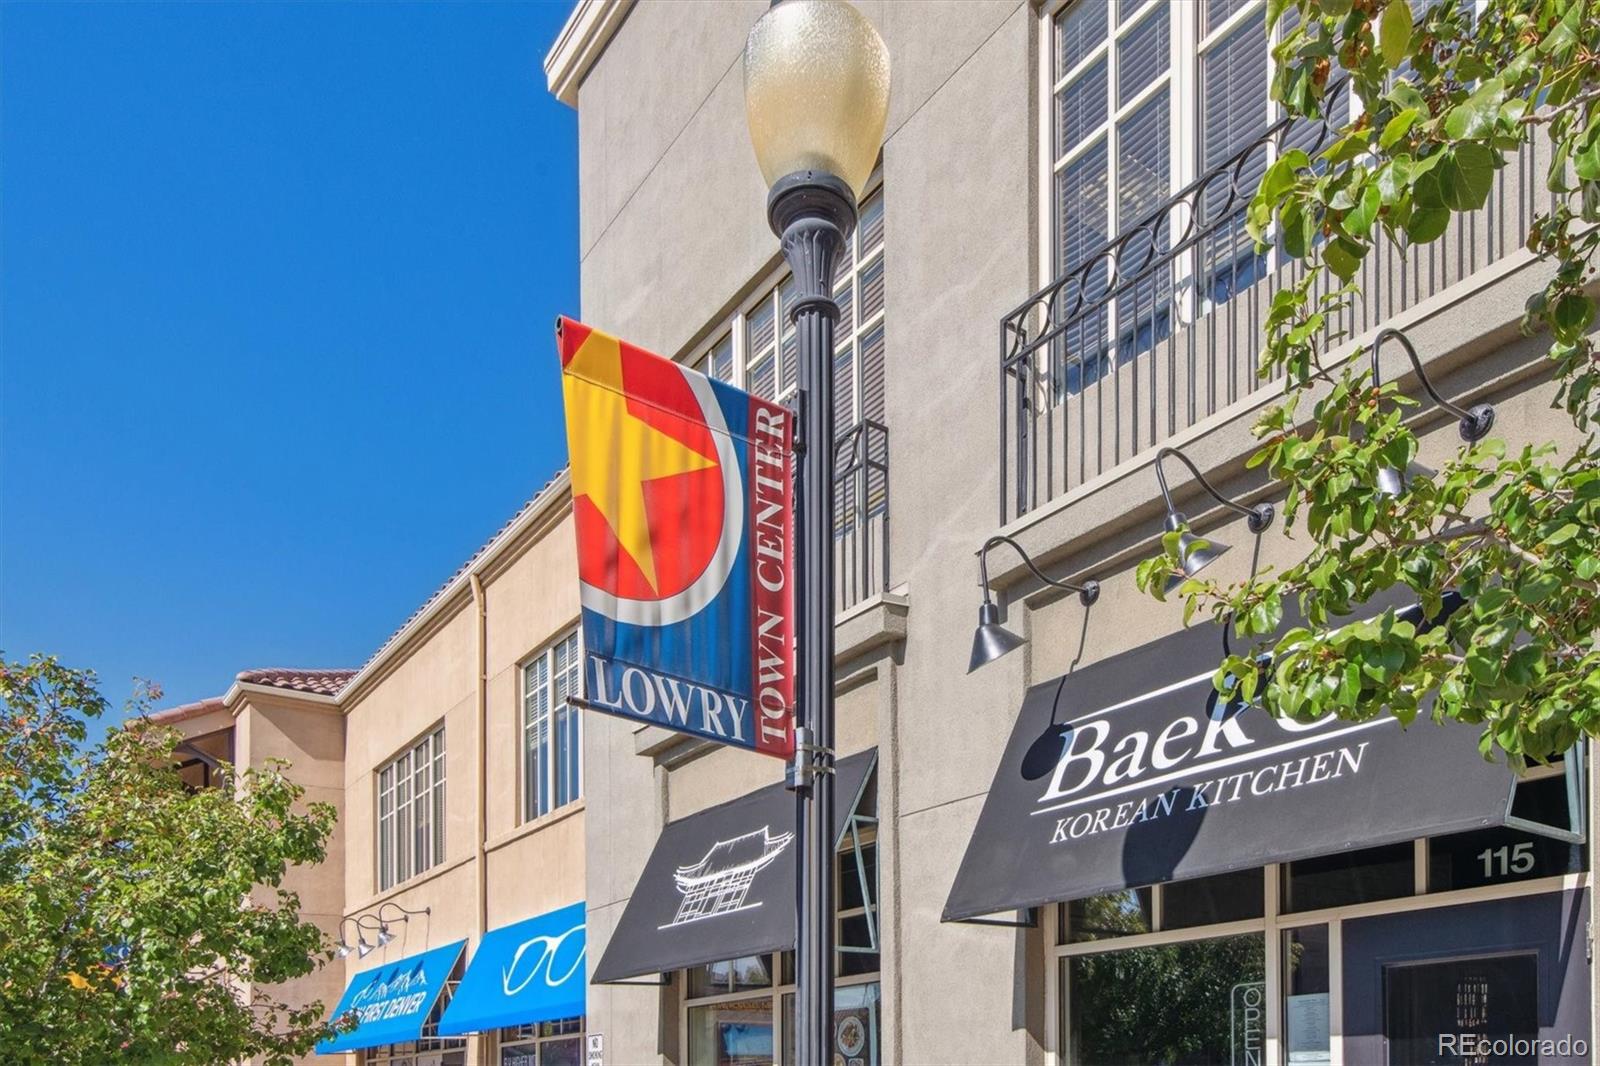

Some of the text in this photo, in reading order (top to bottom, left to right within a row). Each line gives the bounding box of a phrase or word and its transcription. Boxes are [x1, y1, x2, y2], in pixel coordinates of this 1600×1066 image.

[755, 406, 788, 744] TOWN CENTER
[589, 656, 749, 743] LOWRY
[1037, 673, 1262, 803] Baek
[1048, 742, 1371, 844] KOREAN KITCHEN
[1476, 841, 1536, 879] 115
[359, 1000, 390, 1025] FIRST
[383, 991, 428, 1020] DENVER
[1243, 987, 1262, 1066] OPEN
